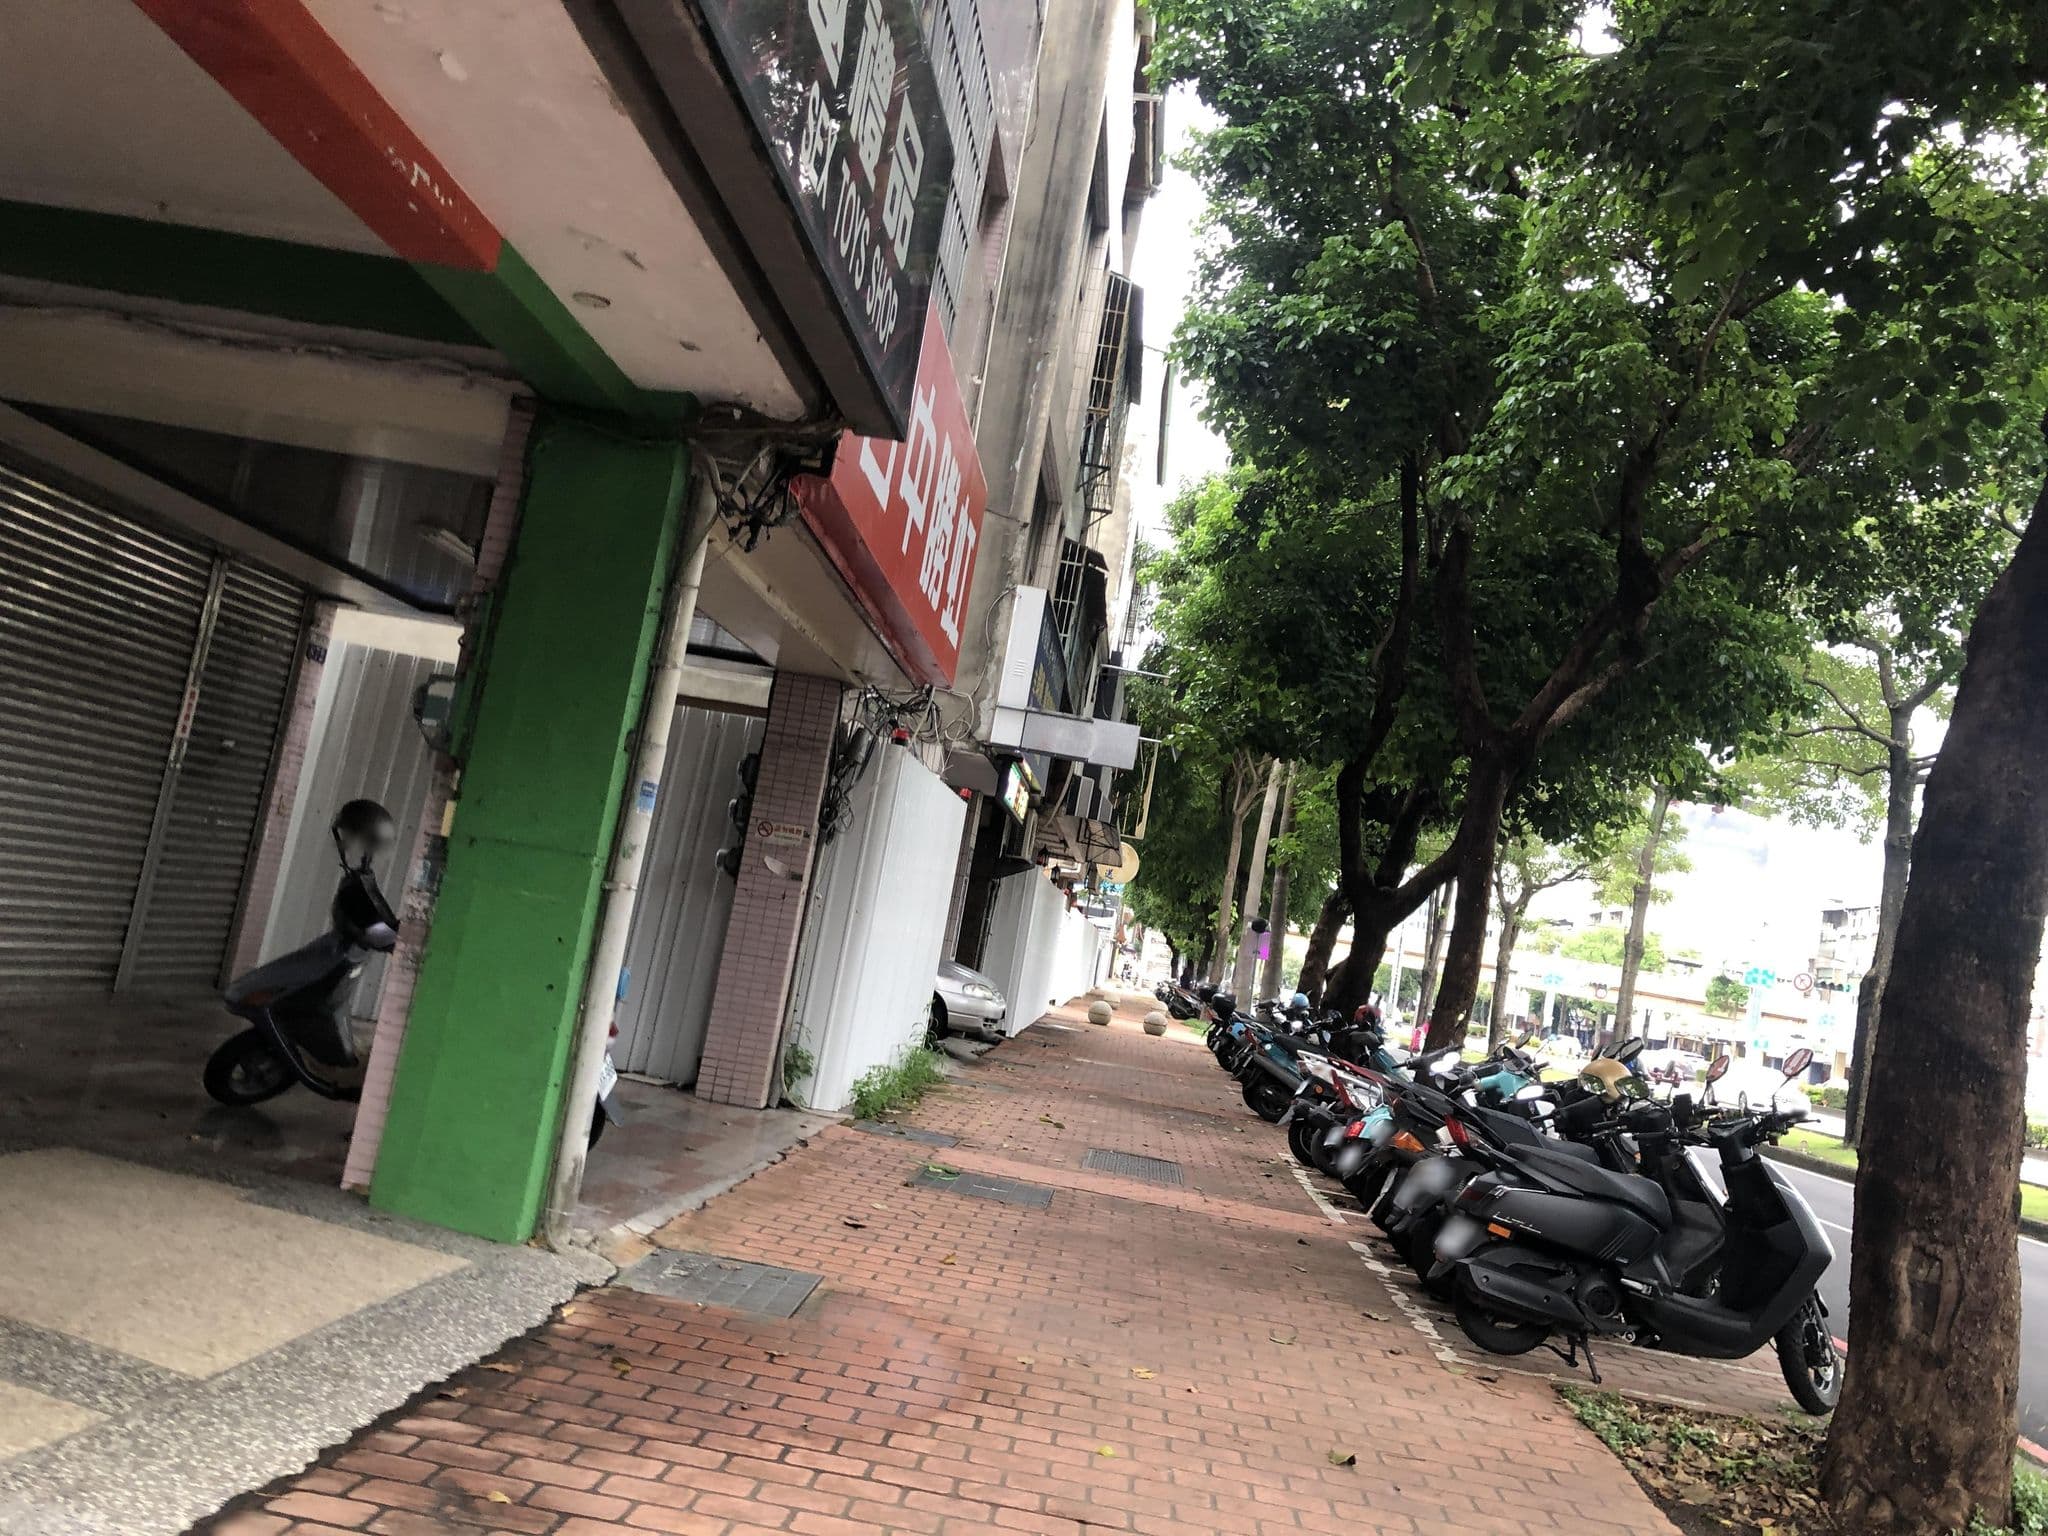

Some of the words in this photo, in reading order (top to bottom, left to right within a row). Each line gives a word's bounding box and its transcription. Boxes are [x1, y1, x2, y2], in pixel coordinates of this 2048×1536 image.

[801, 80, 838, 211] SEX
[833, 157, 870, 291] TOYS
[866, 244, 899, 353] SHOP
